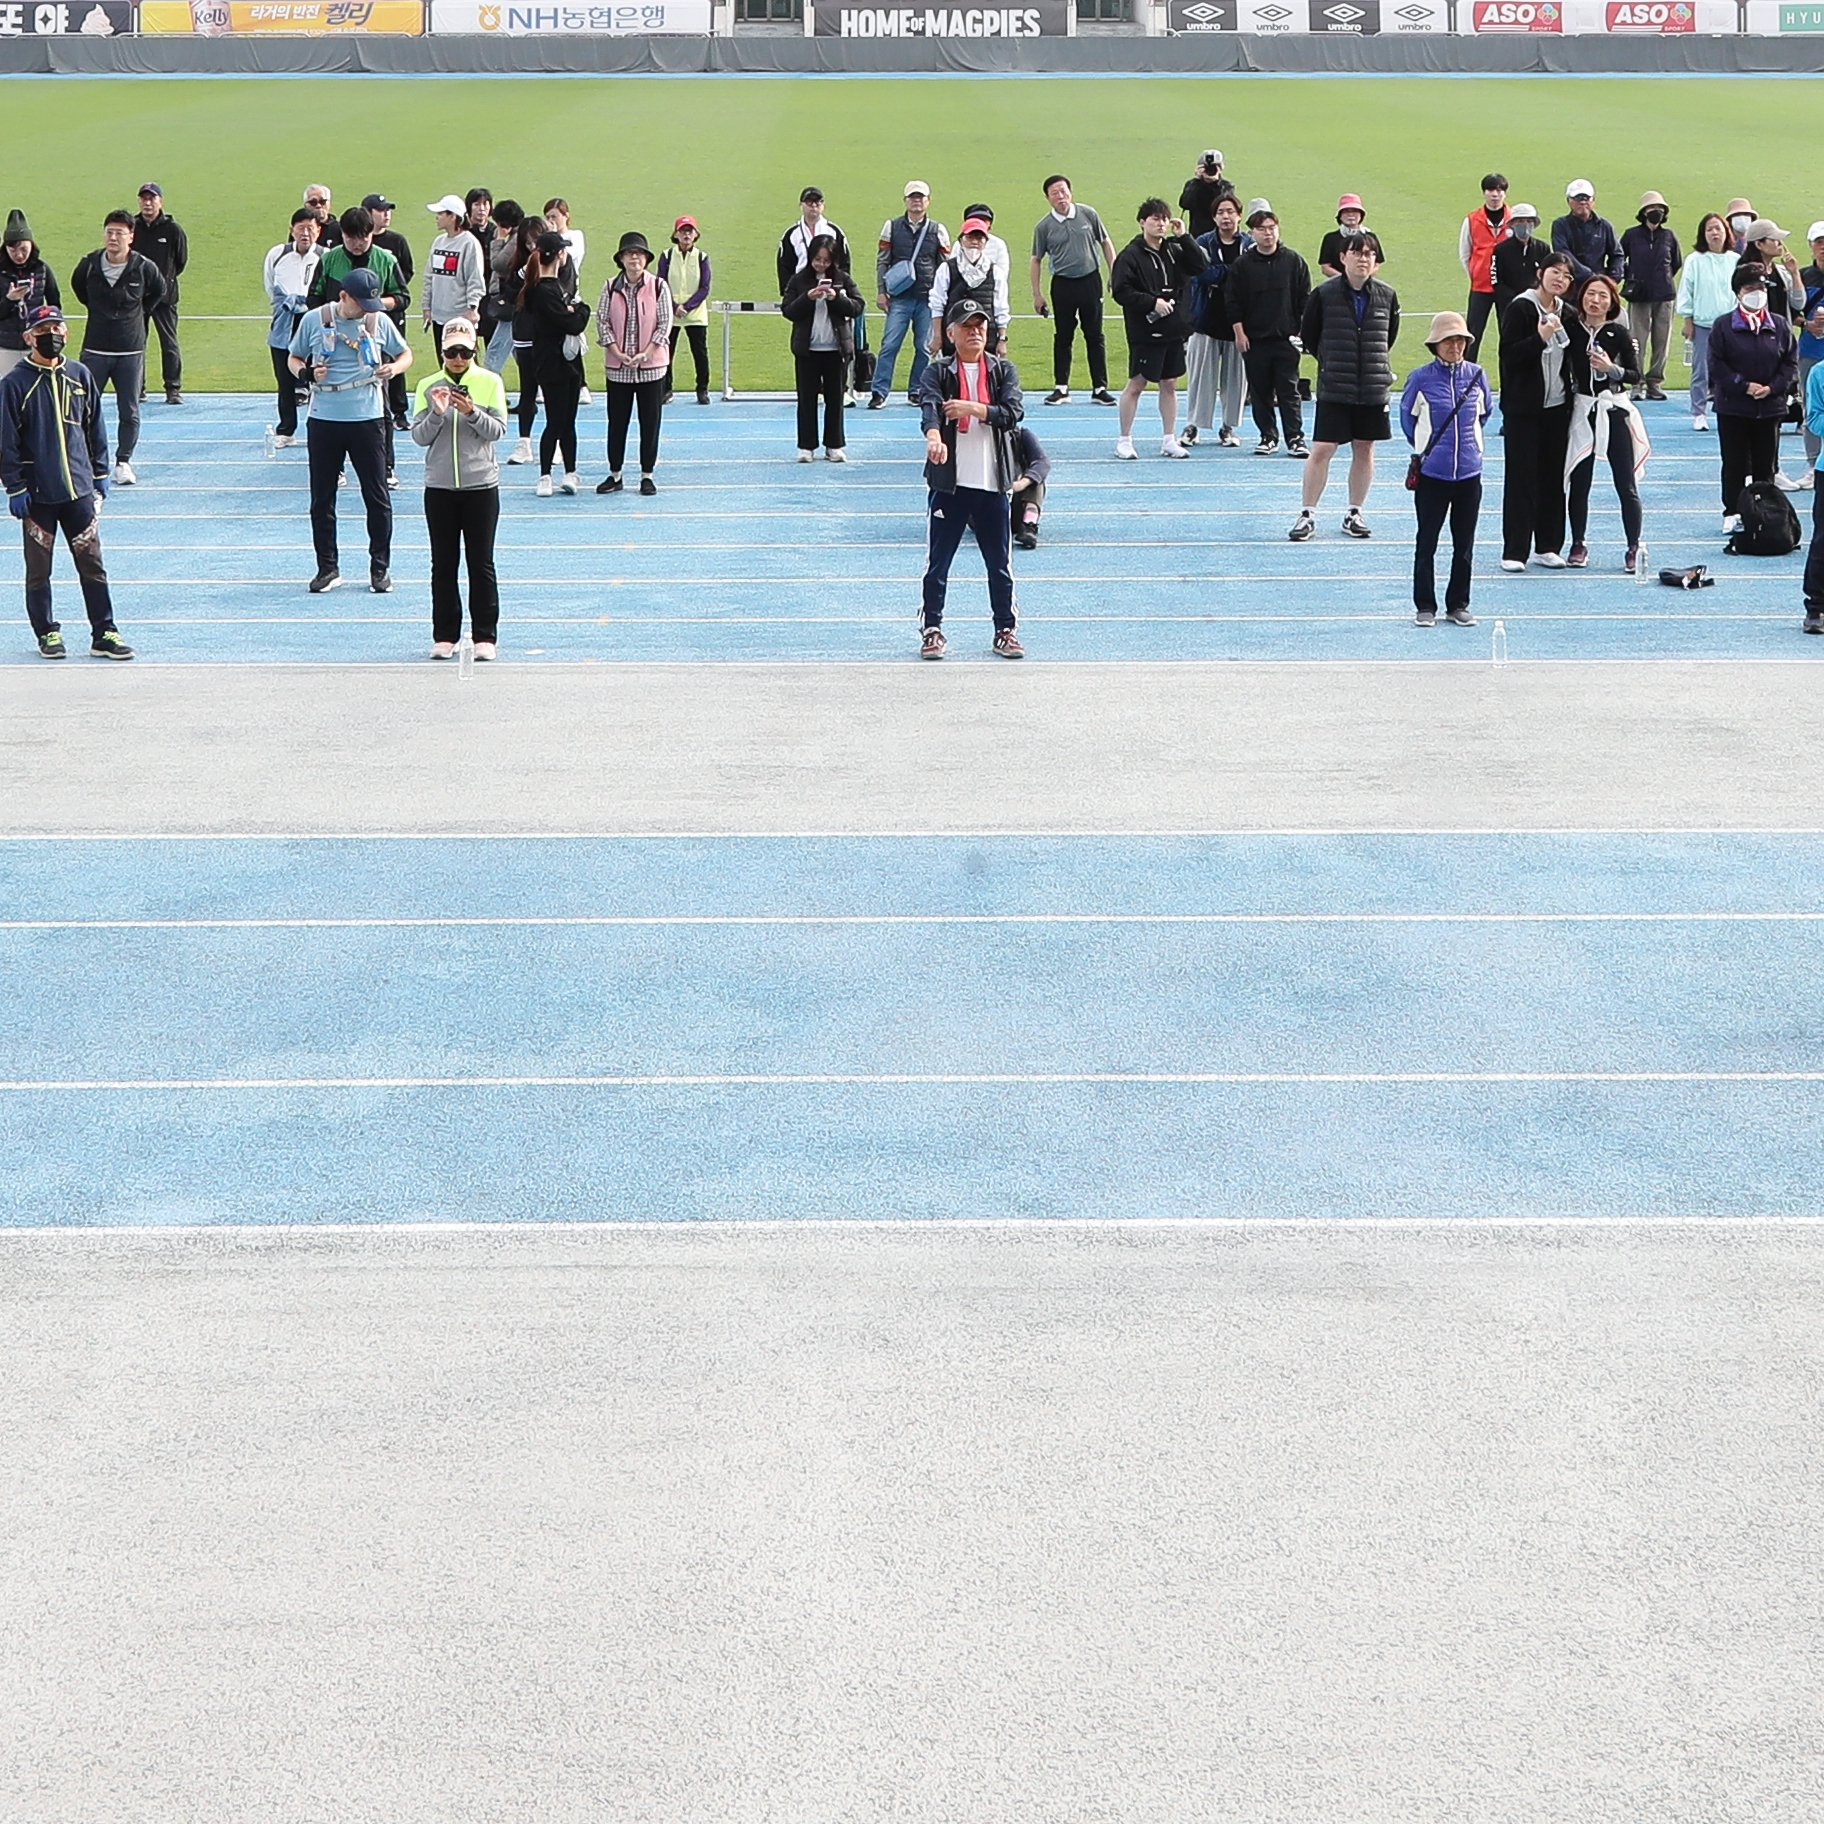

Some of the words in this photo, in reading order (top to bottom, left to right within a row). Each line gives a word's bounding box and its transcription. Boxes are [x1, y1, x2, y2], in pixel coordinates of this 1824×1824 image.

[194, 9, 229, 27] Kelly
[250, 4, 291, 20] 라거의
[292, 3, 320, 20] 반전
[508, 5, 666, 30] NH농협은행
[1481, 4, 1536, 24] ASO
[1614, 4, 1669, 24] ASO
[840, 8, 914, 37] HOME
[910, 17, 925, 32] OF
[925, 8, 1041, 37] MAGPIES
[1186, 22, 1222, 31] umbro
[1256, 23, 1290, 32] umbro
[1327, 22, 1362, 31] umbro
[1397, 23, 1432, 31] umbro
